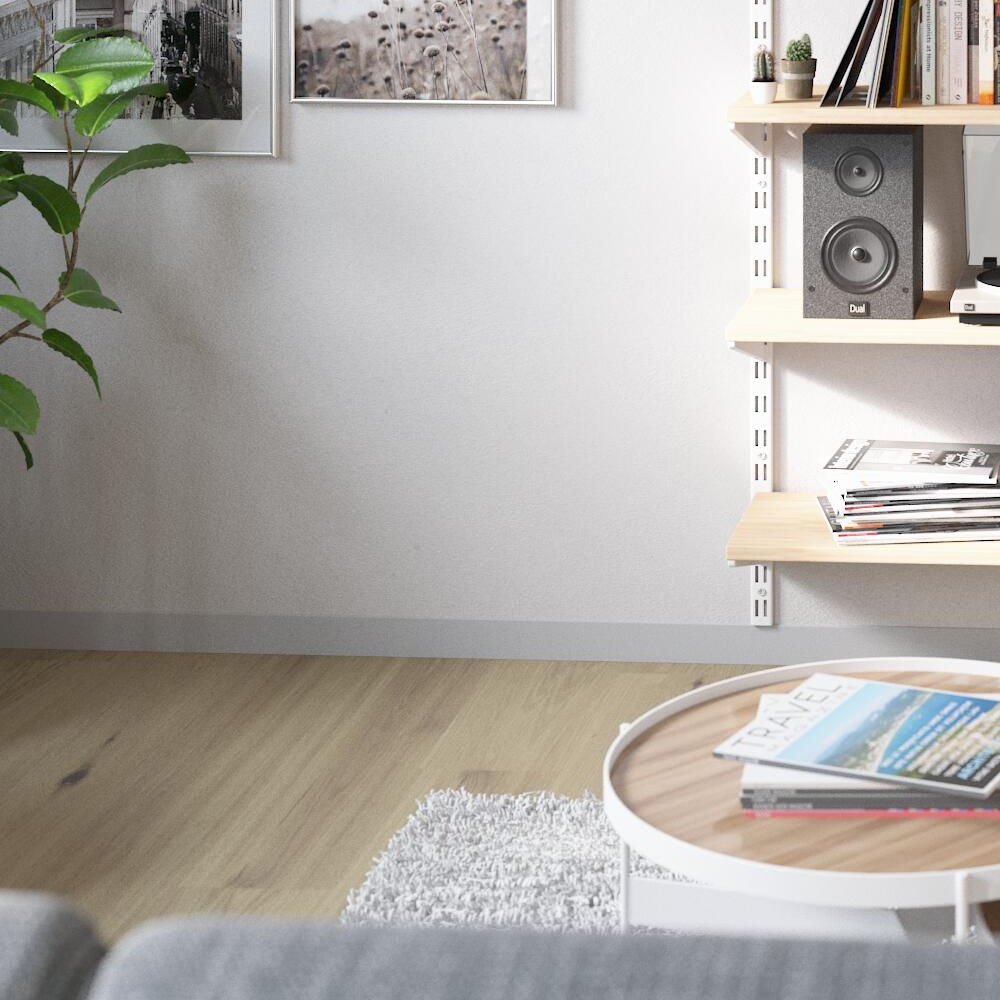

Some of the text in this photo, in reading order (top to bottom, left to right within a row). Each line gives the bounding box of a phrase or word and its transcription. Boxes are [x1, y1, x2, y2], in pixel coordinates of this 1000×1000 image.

[954, 12, 963, 40] DESIGN
[849, 303, 866, 313] Dual
[730, 681, 843, 750] TRAVEL
